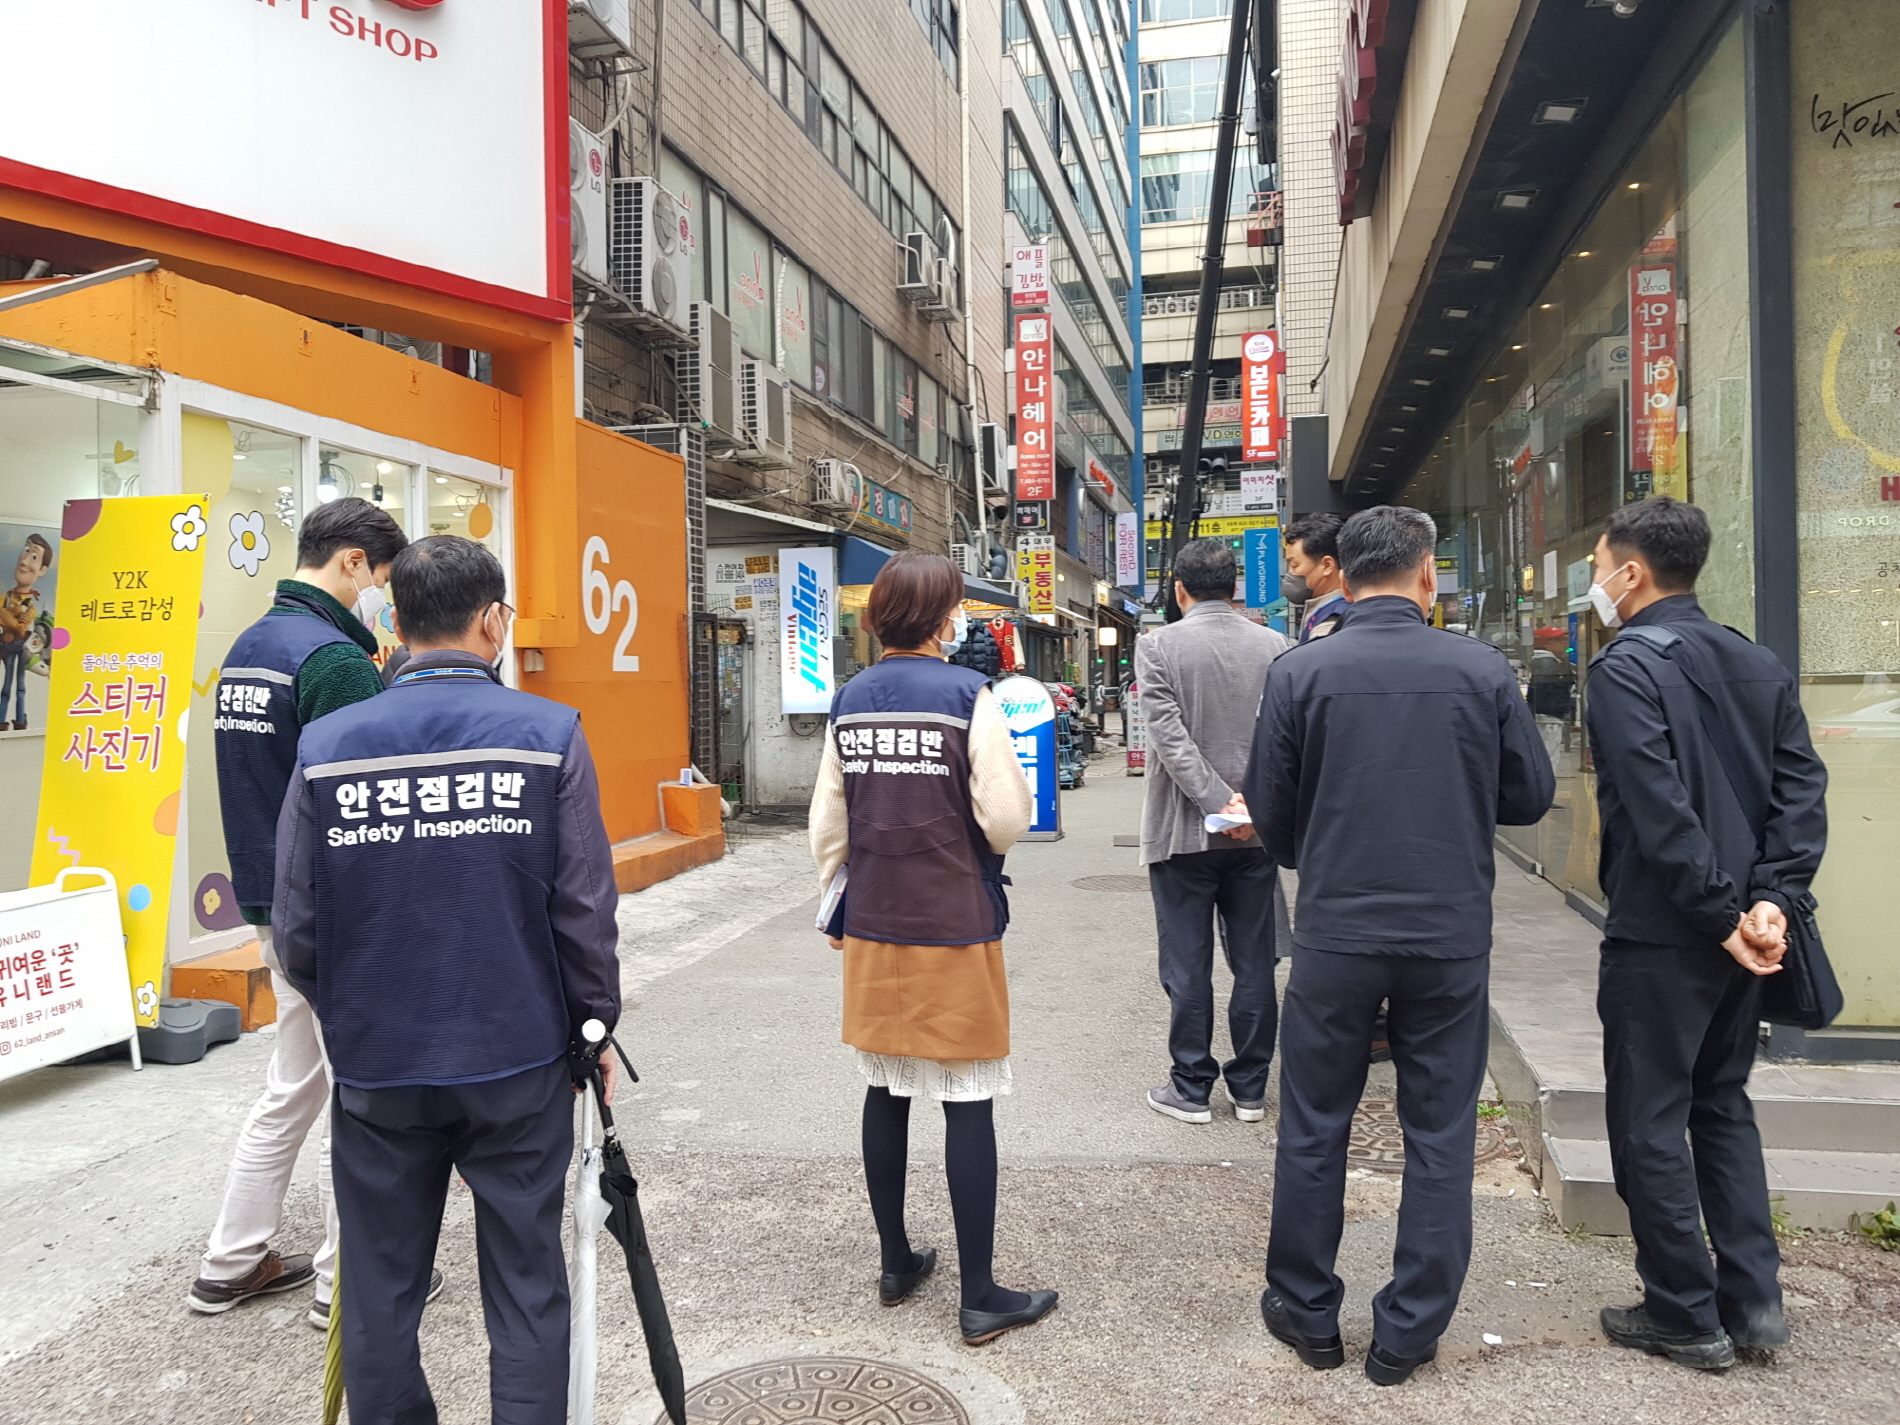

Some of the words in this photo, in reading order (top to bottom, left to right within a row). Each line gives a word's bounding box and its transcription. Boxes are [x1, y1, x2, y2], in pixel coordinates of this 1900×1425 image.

[329, 5, 438, 62] SHOP
[1016, 249, 1043, 268] 애플
[1016, 272, 1044, 289] 김밥
[1021, 347, 1047, 450] 안나헤어
[1249, 364, 1271, 447] 보드카페
[1246, 449, 1258, 458] 5F
[1027, 486, 1043, 497] 2F
[1034, 537, 1052, 545] 대우
[112, 570, 149, 589] Y2K
[1033, 553, 1053, 612] 부동산
[1257, 550, 1267, 604] PLAYGROUND
[80, 596, 174, 622] 레트로감성
[582, 535, 640, 672] 62
[818, 586, 829, 665] SECRT
[82, 654, 120, 671] 돌아온
[124, 652, 163, 670] 추억의
[69, 674, 167, 720] 스티커
[219, 684, 272, 715] 전점검반
[63, 725, 161, 772] 사진기
[838, 728, 944, 757] 안전점검반
[873, 758, 950, 777] Inspection
[335, 772, 526, 820] 안전점검반
[327, 822, 405, 847] Safety
[413, 814, 532, 838] Inspection
[15, 929, 41, 944] LAND
[25, 1009, 43, 1025] 문구
[50, 998, 84, 1017] 선물가게
